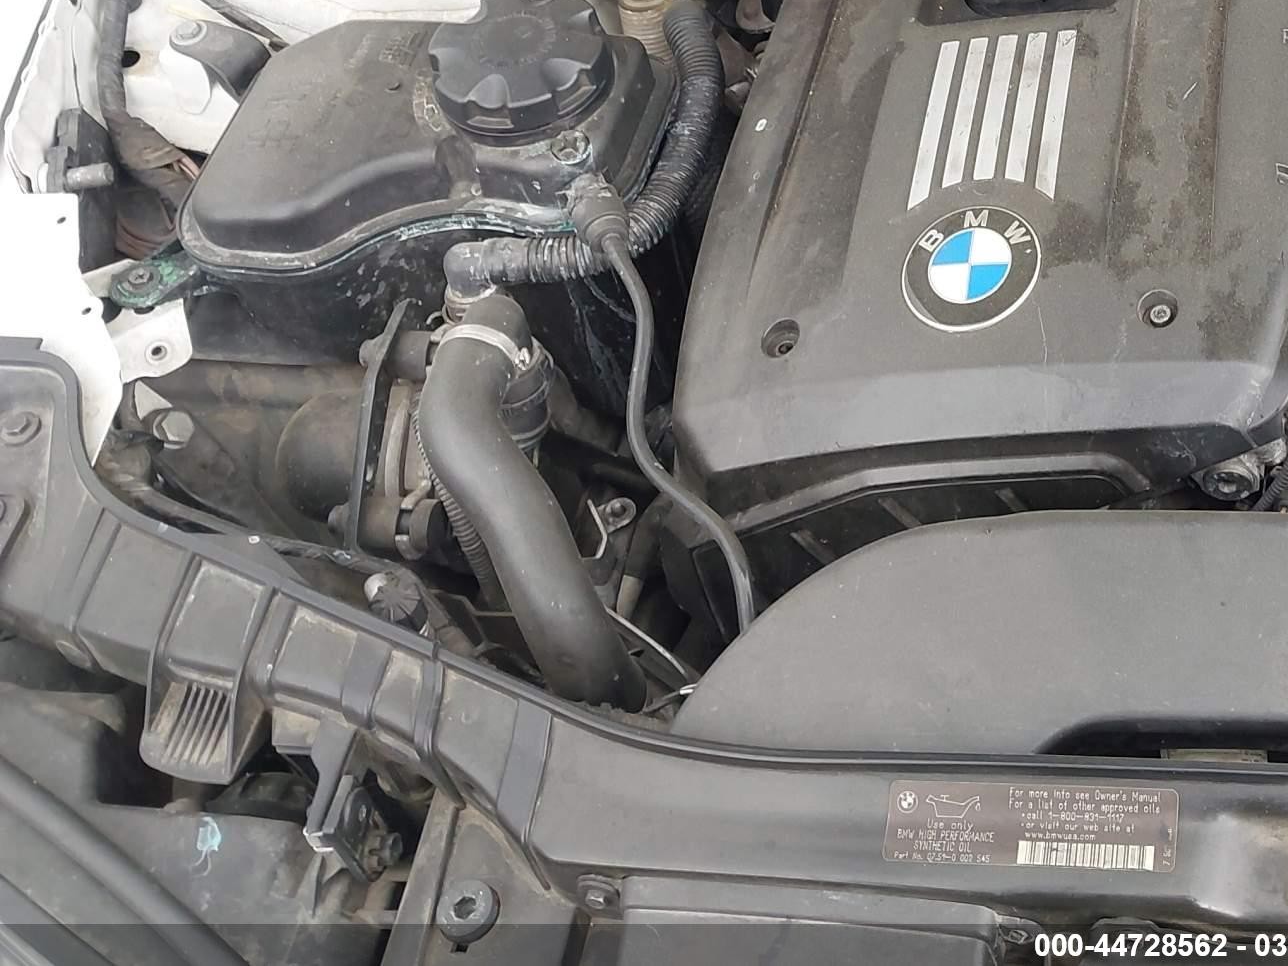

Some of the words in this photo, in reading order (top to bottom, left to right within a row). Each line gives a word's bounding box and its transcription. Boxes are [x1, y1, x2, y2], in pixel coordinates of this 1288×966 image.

[918, 208, 1032, 253] BMW
[1009, 786, 1024, 798] For
[1028, 790, 1049, 799] more
[1075, 792, 1090, 800] see
[1094, 789, 1127, 801] Owner's
[1131, 791, 1161, 803] Manual
[1009, 797, 1023, 810] For
[1028, 801, 1033, 809] a
[1038, 798, 1053, 810] list
[1058, 800, 1067, 811] of
[1072, 800, 1095, 811] other
[1100, 802, 1139, 814] approved
[1143, 803, 1160, 814] oils
[1048, 811, 1124, 823] 1-800-831-1117
[927, 818, 945, 829] Use
[951, 820, 974, 832] only
[1039, 820, 1060, 830] visit
[1083, 823, 1099, 832] web
[1104, 823, 1121, 833] site
[1126, 823, 1135, 833] at
[896, 828, 915, 839] BMW
[919, 830, 937, 840] HIGH
[940, 830, 995, 843] PERFORMANCE
[913, 840, 956, 852] SYNTHETIC
[958, 841, 972, 853] OIL
